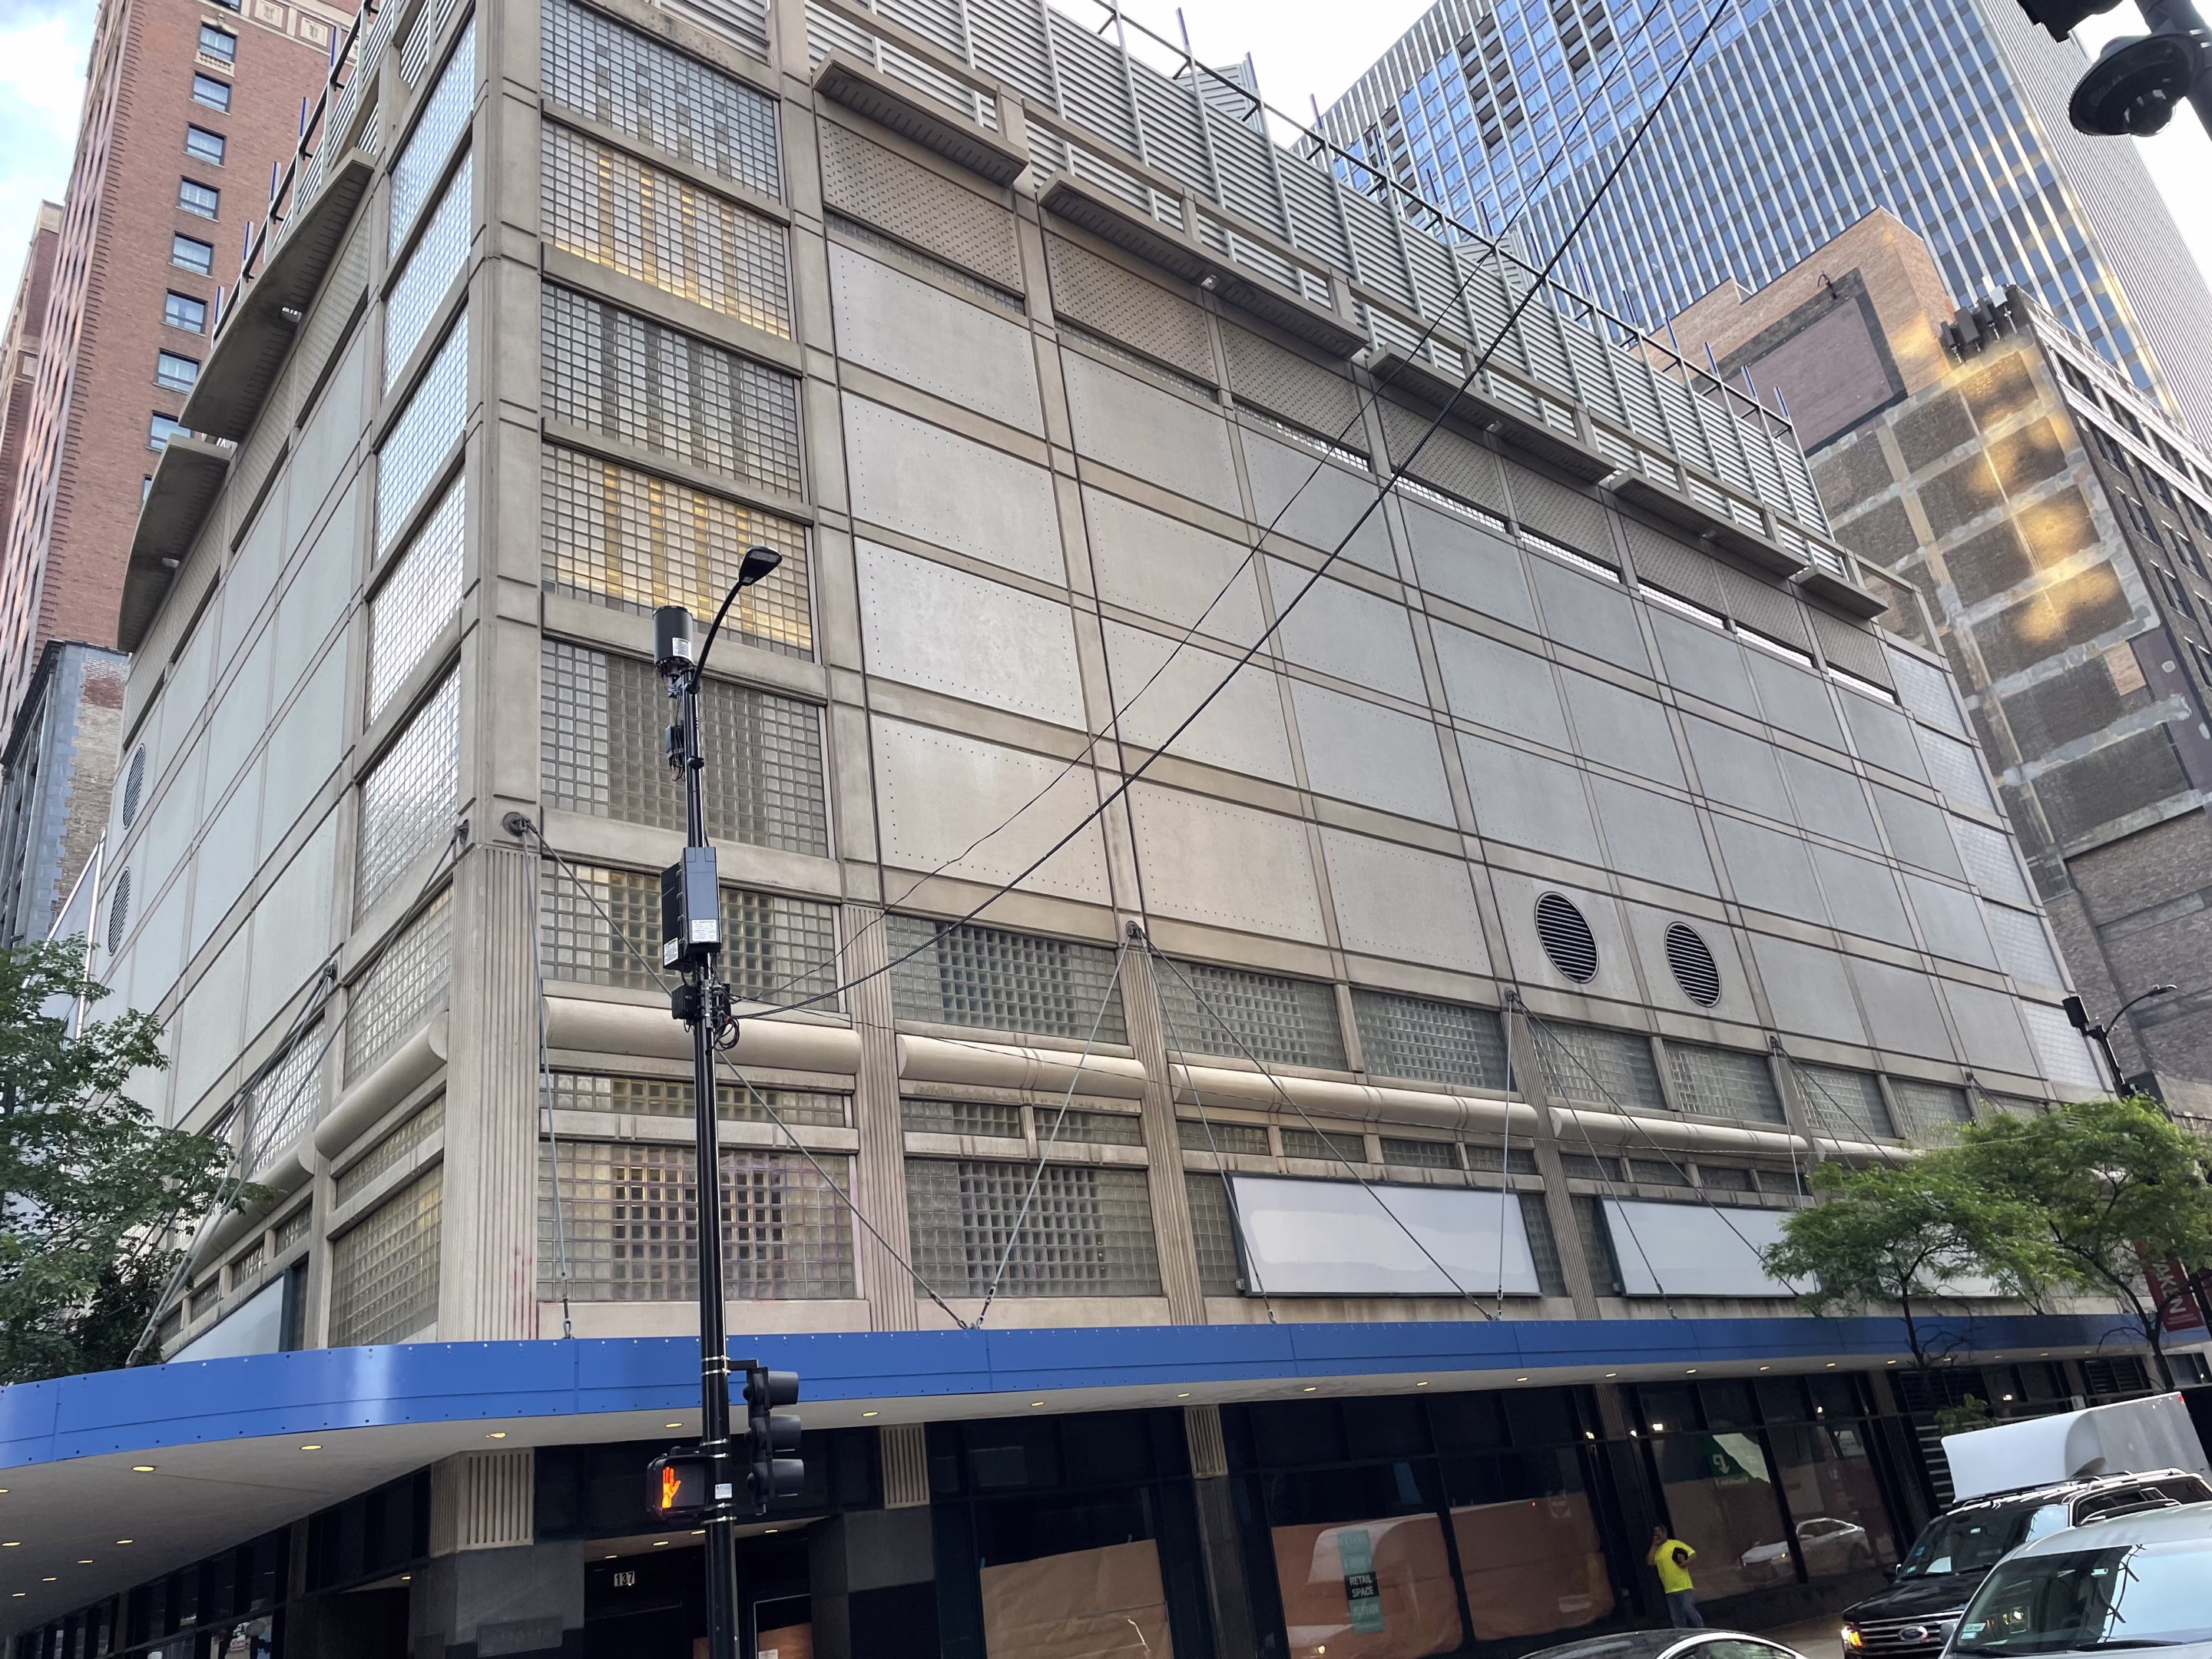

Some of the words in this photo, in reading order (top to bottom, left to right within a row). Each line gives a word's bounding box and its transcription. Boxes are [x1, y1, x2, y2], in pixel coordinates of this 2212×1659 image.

[616, 1571, 634, 1585] 137
[1349, 1574, 1373, 1586] RETAIL
[1352, 1585, 1375, 1598] SPACE
